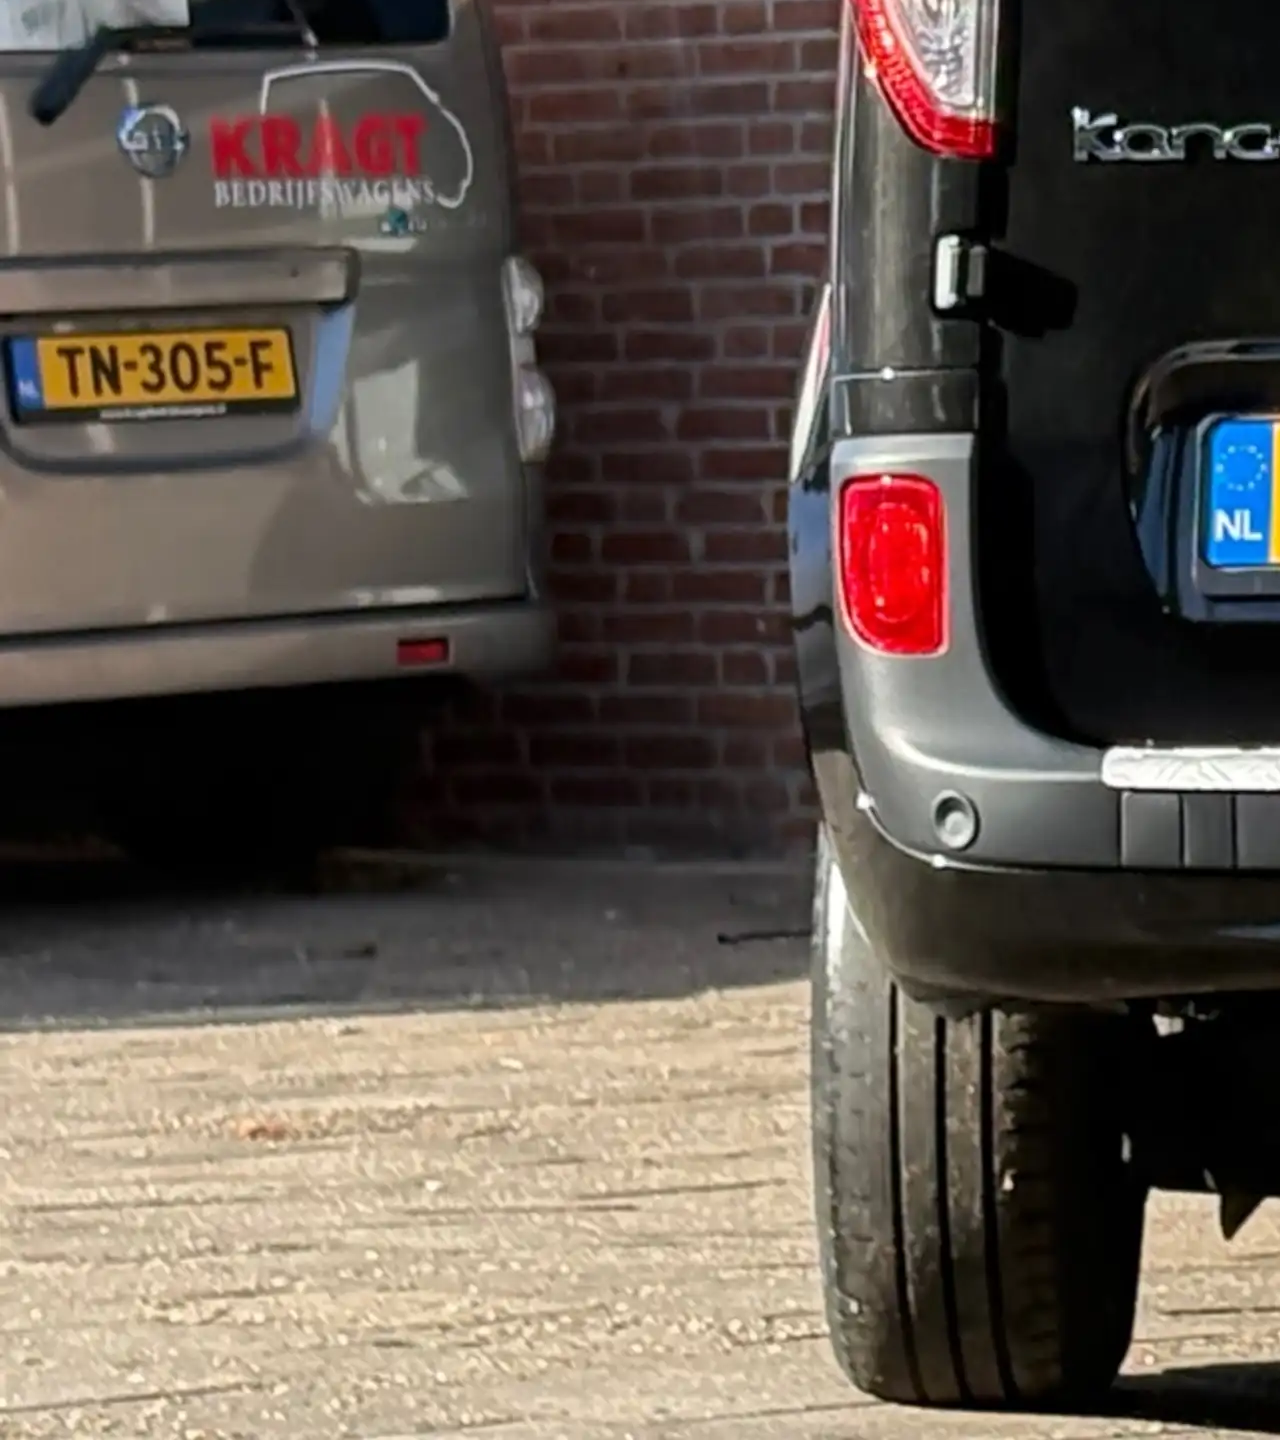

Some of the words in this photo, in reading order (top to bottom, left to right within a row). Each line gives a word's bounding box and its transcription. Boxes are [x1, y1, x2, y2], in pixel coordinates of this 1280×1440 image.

[208, 113, 427, 179] KRAGT
[55, 339, 274, 398] TN-305-F
[1213, 511, 1263, 543] NL
